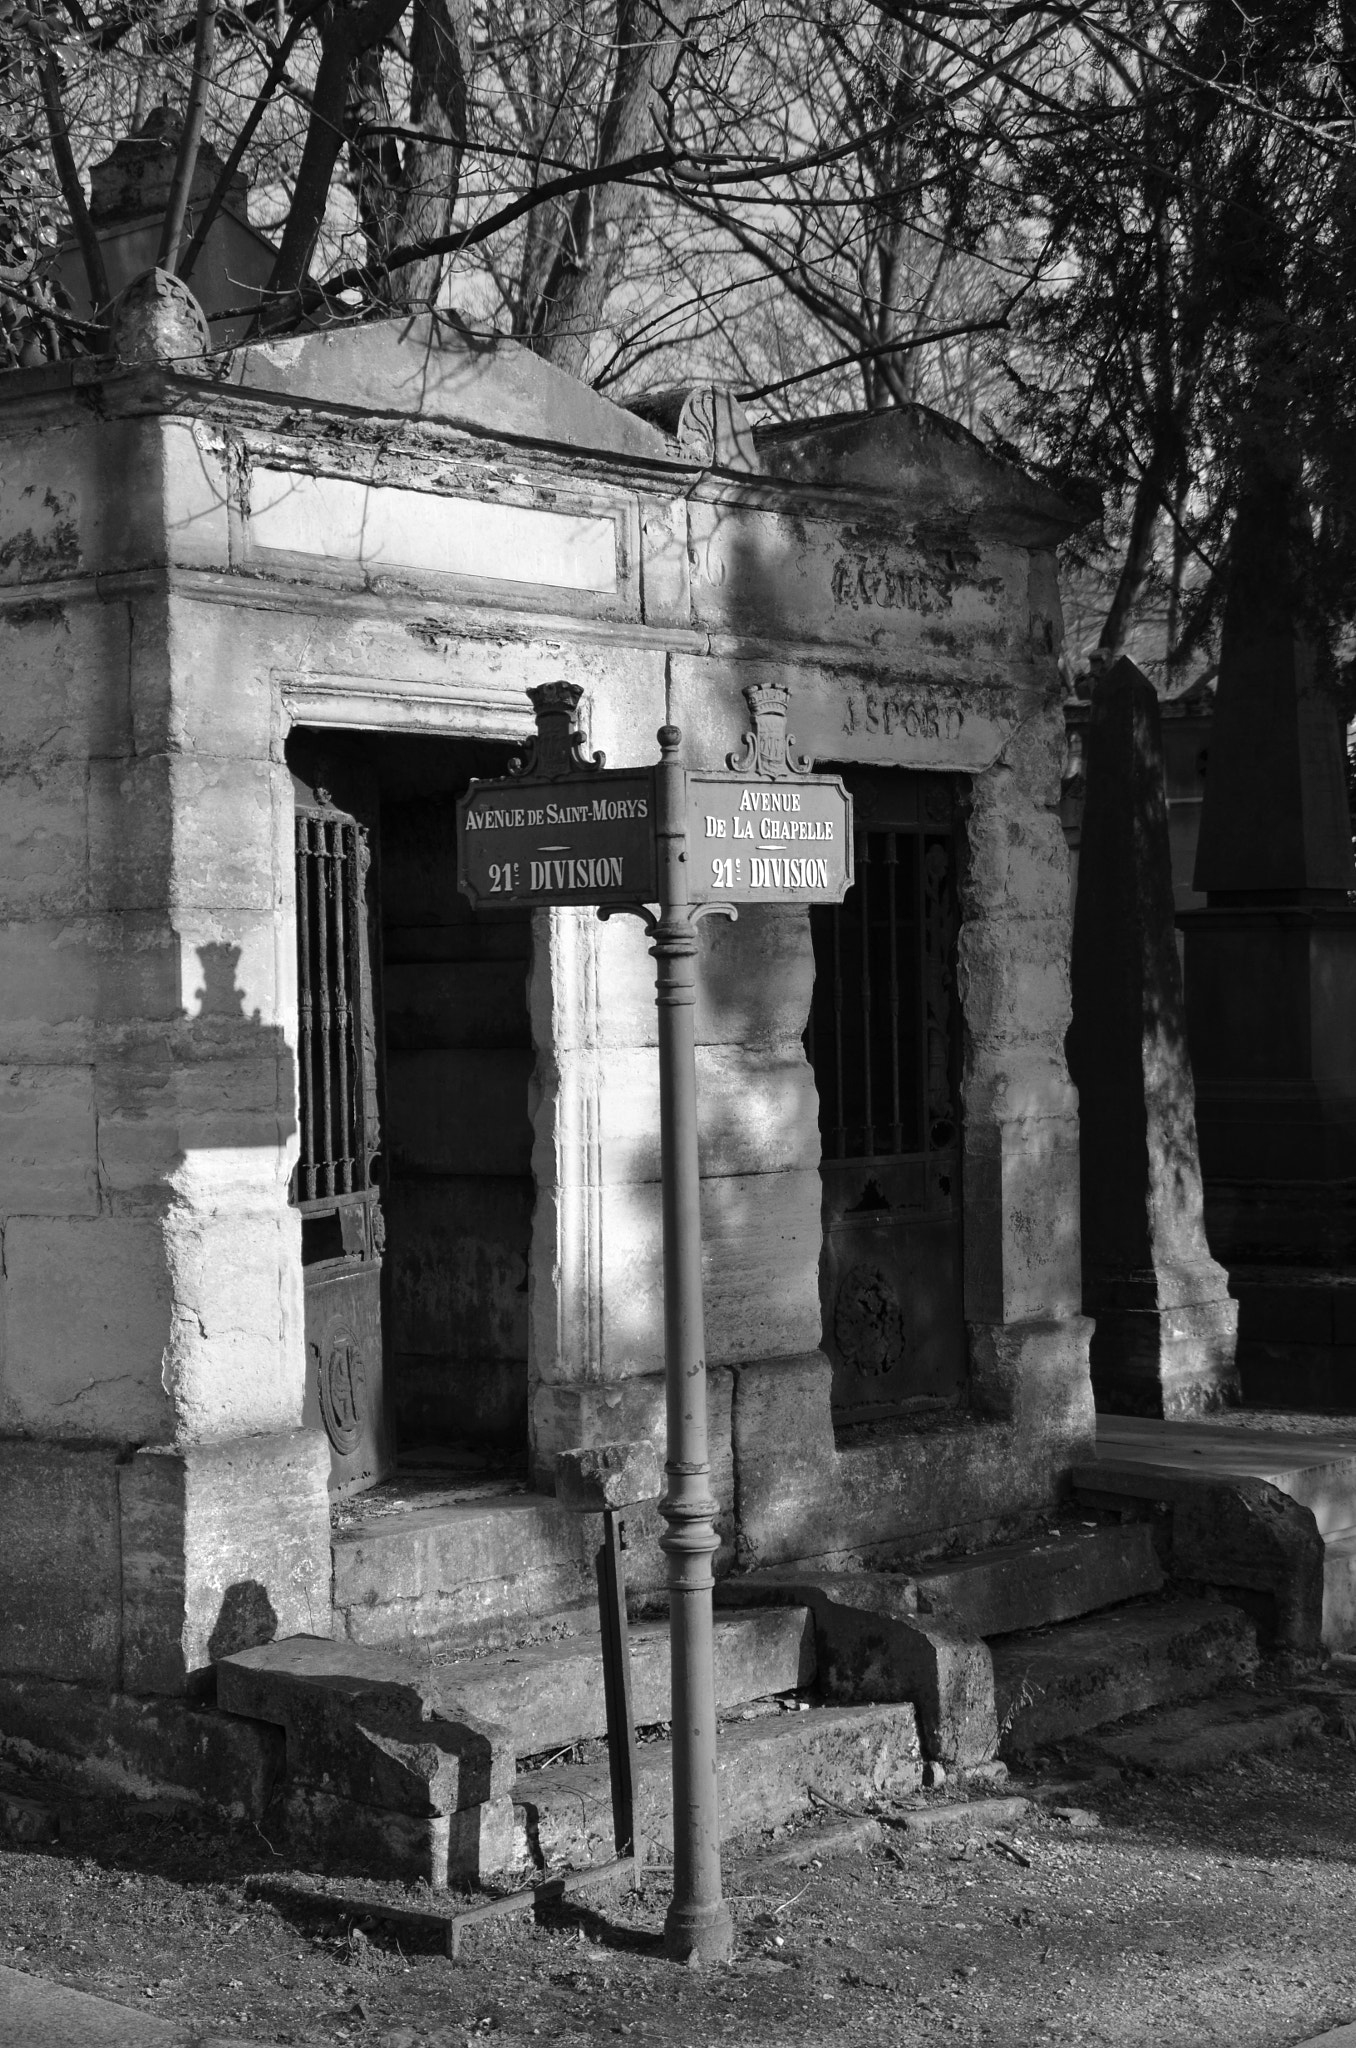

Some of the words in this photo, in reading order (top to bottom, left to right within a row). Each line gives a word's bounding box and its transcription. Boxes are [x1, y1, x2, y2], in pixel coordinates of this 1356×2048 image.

[465, 809, 525, 830] AVENUE
[527, 809, 545, 826] DE
[546, 799, 648, 824] SAINT-MORYS
[739, 789, 801, 812] AVENUE
[705, 816, 727, 838] DE
[733, 816, 755, 839] LA
[760, 818, 834, 840] CHAPELLE
[530, 857, 624, 890] DIVISION
[750, 858, 828, 888] DIVISION
